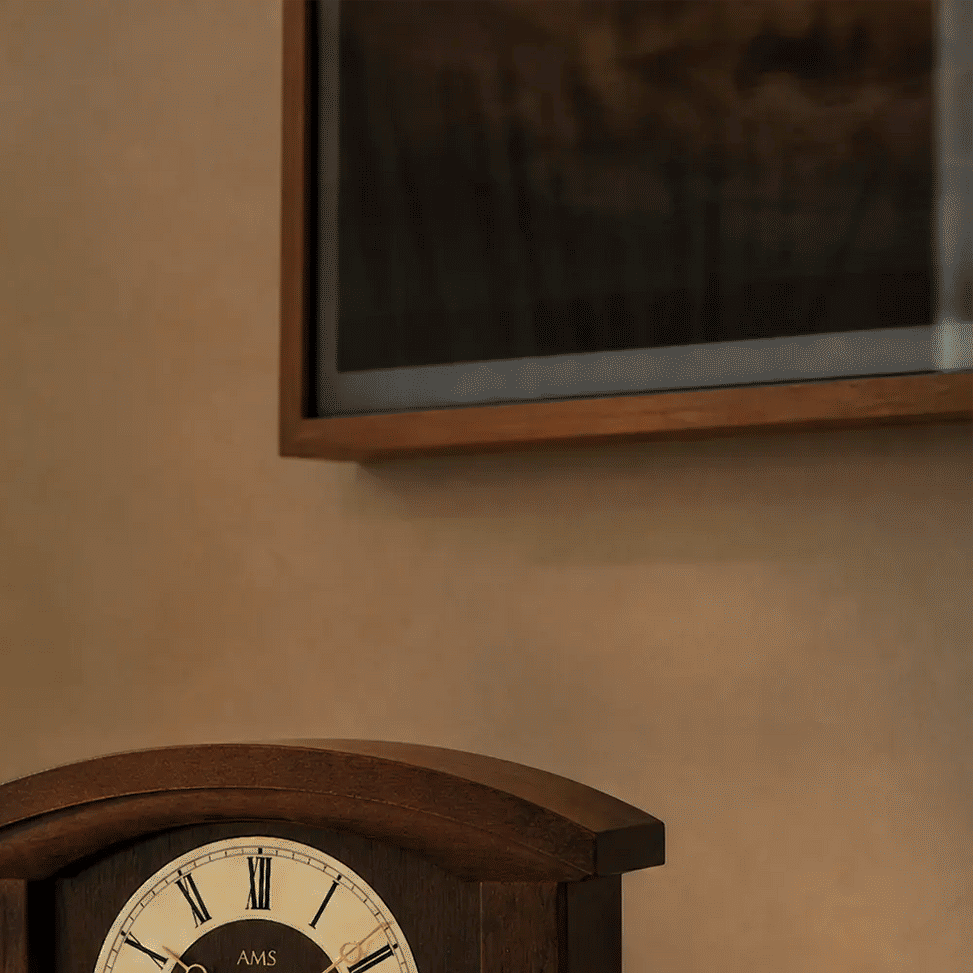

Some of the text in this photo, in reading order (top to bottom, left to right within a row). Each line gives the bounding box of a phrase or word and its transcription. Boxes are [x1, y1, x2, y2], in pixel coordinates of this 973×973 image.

[174, 872, 213, 929] XI
[245, 856, 273, 911] XII
[308, 879, 340, 930] I
[124, 931, 169, 970] X
[236, 949, 277, 967] AMS
